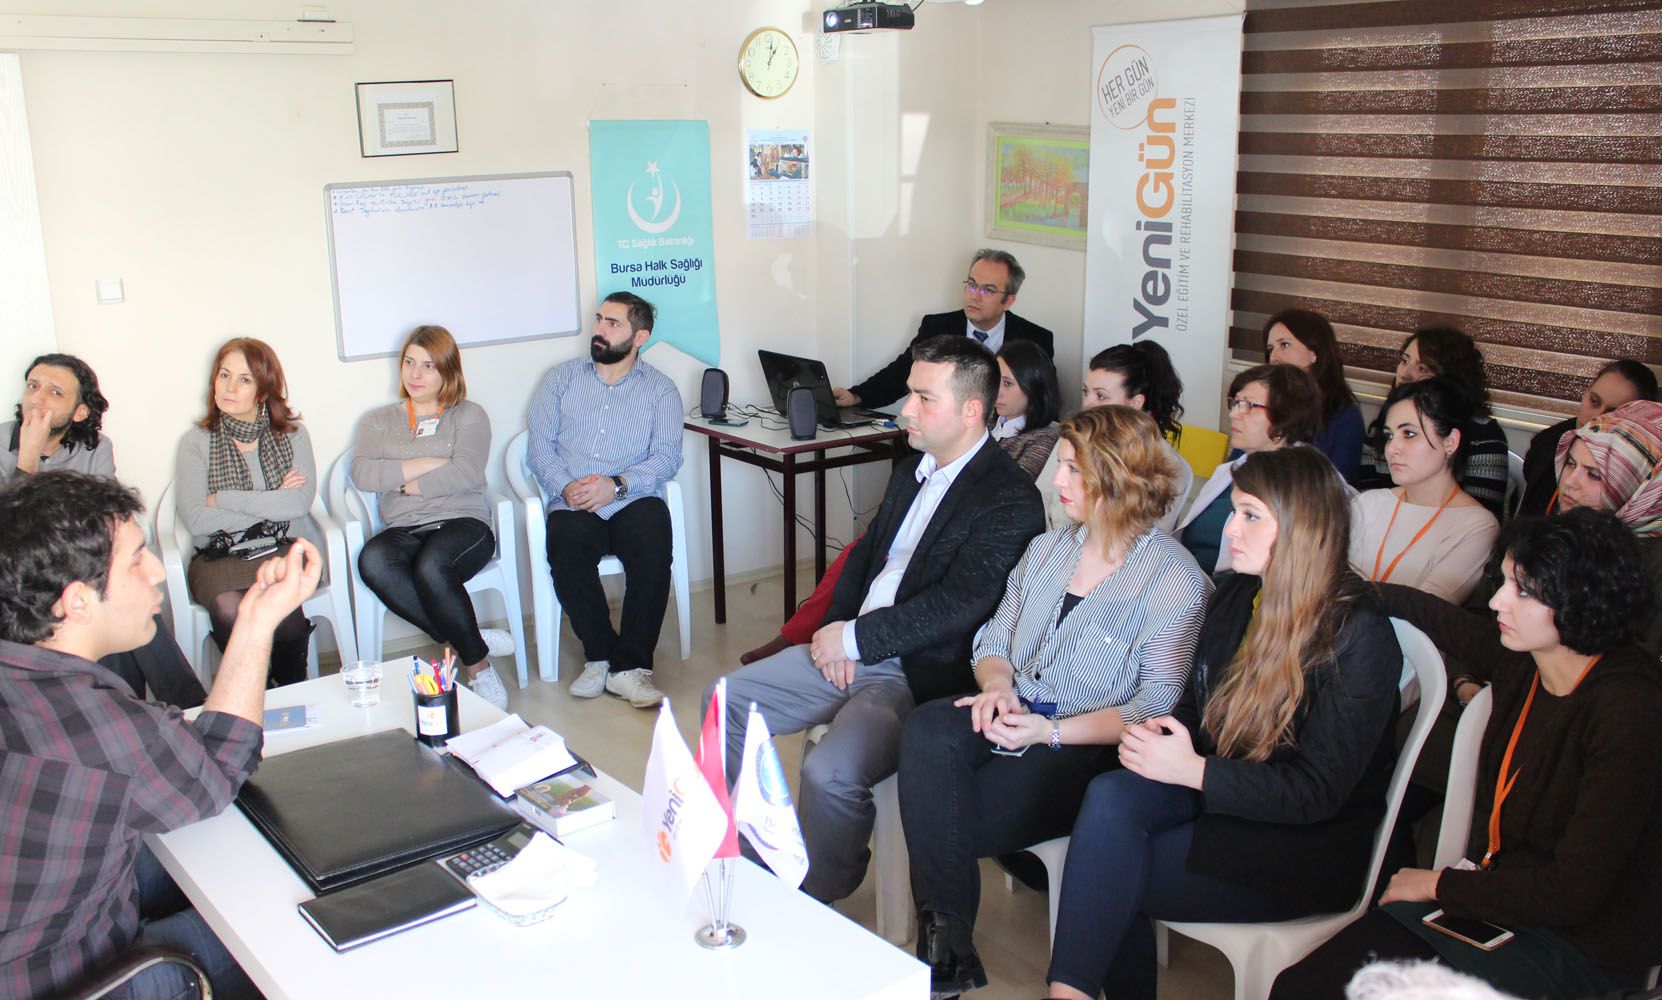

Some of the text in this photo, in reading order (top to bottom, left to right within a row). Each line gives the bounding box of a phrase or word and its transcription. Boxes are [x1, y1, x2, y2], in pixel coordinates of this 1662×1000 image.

[1102, 56, 1149, 104] HER GÜN
[1138, 77, 1155, 96] GÜN
[1132, 98, 1177, 340] YeniGün
[1180, 247, 1191, 261] VE
[611, 258, 703, 274] Bursa Halk Sağlığı
[631, 274, 686, 287] Müdürlüğü
[1175, 305, 1189, 332] ÖZEL
